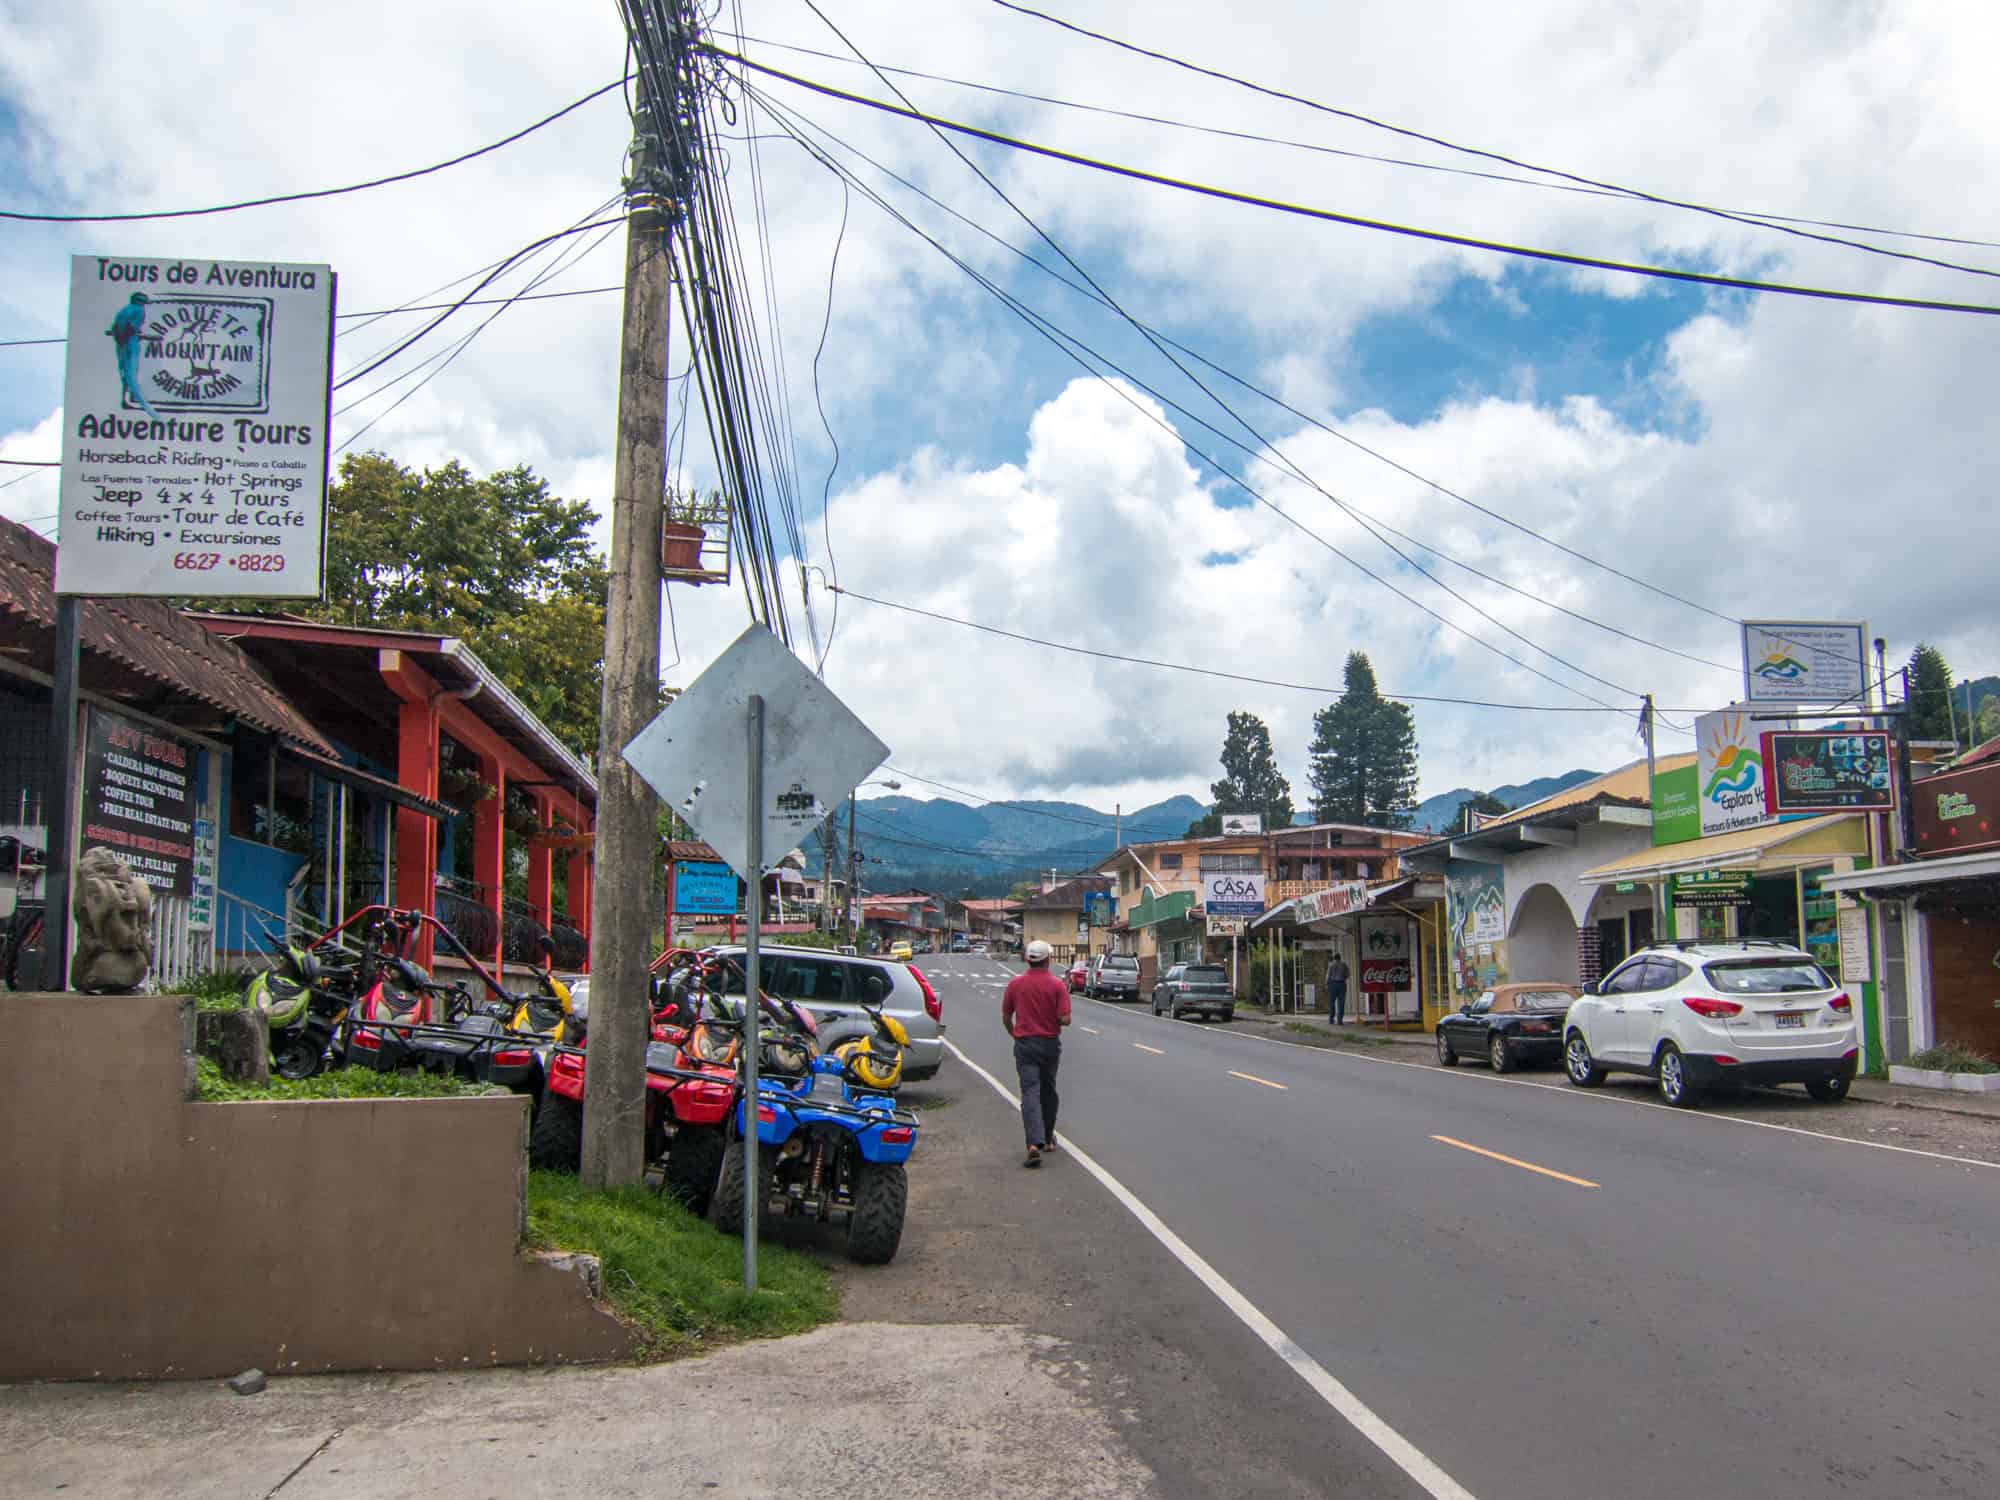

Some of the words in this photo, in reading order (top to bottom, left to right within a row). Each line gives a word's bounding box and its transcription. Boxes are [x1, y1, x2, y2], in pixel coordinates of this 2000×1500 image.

[97, 258, 159, 282] Tours
[166, 262, 199, 285] de
[206, 264, 316, 290] Aventura
[150, 304, 248, 339] BOQUETE
[145, 342, 253, 362] MOUNTAIN
[152, 369, 242, 400] SAFARI.COM
[78, 413, 224, 442] Adventure
[233, 418, 312, 445] Tours
[79, 449, 167, 465] Horseback
[172, 451, 223, 470] Riding
[205, 472, 235, 486] Hot
[240, 473, 303, 491] Springs
[93, 485, 142, 508] Jeep
[156, 487, 171, 504] 4
[200, 488, 215, 505] 4
[230, 489, 289, 507] Tours
[75, 510, 122, 522] Coffee
[126, 512, 161, 523] Tours
[172, 507, 219, 524] Tour
[225, 510, 248, 525] de
[255, 511, 304, 527] Café
[97, 526, 155, 546] Hiking
[180, 529, 281, 546] Excursiones
[174, 552, 221, 570] 6627
[238, 554, 285, 572] 8829
[1721, 792, 1753, 813] Explora
[1213, 879, 1257, 896] CASA
